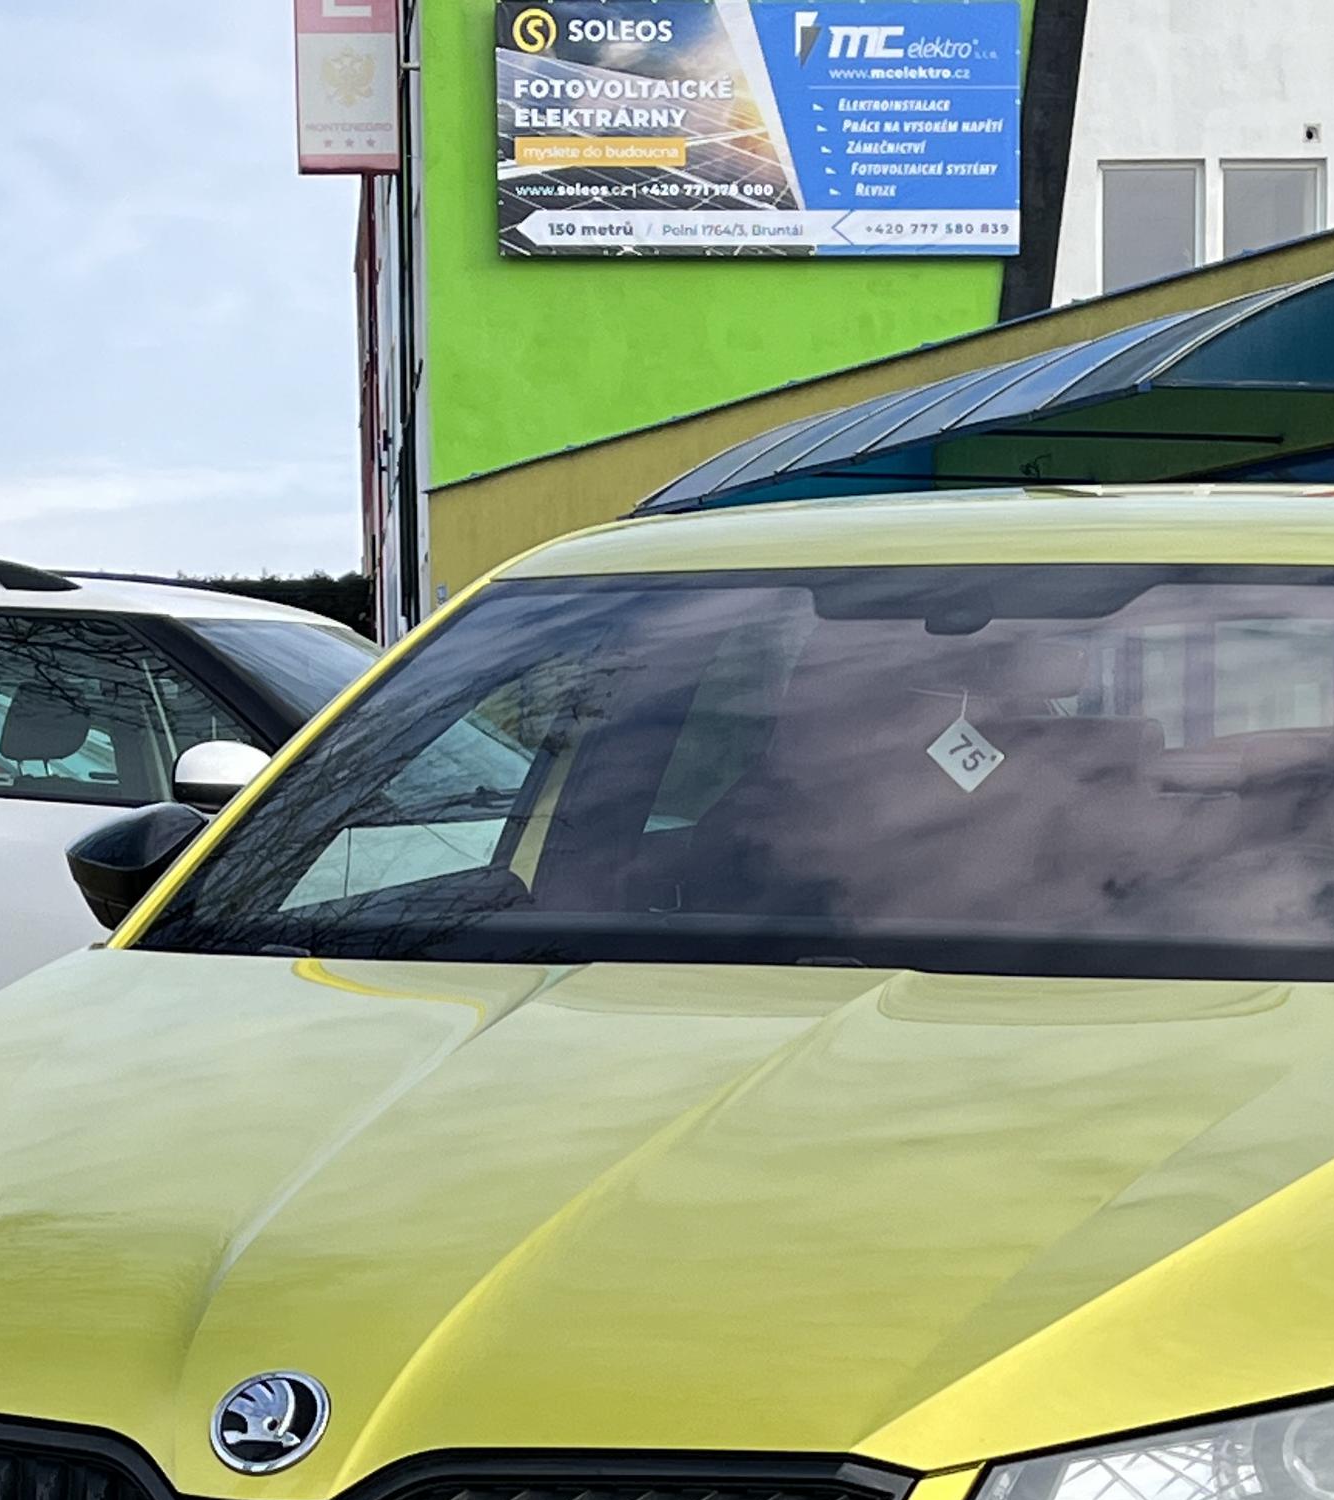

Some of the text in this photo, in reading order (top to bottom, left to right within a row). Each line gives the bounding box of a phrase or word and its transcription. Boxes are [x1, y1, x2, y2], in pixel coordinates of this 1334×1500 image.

[567, 19, 673, 43] SOLEOS
[907, 36, 972, 59] elektro
[829, 66, 971, 79] www.mcelektro.cz
[514, 73, 733, 99] FOTOVOLTAICKÉ
[514, 104, 687, 128] ELEKTRÁRNY
[883, 121, 900, 132] NA
[583, 145, 601, 159] do
[605, 145, 680, 159] budoucna
[640, 183, 678, 196] +420
[548, 223, 575, 235] 150
[581, 222, 633, 235] metrů
[662, 224, 698, 236] Polní
[752, 224, 804, 236] Bruntál
[866, 223, 904, 234] +420
[910, 223, 939, 234] 777
[948, 733, 986, 771] 75
